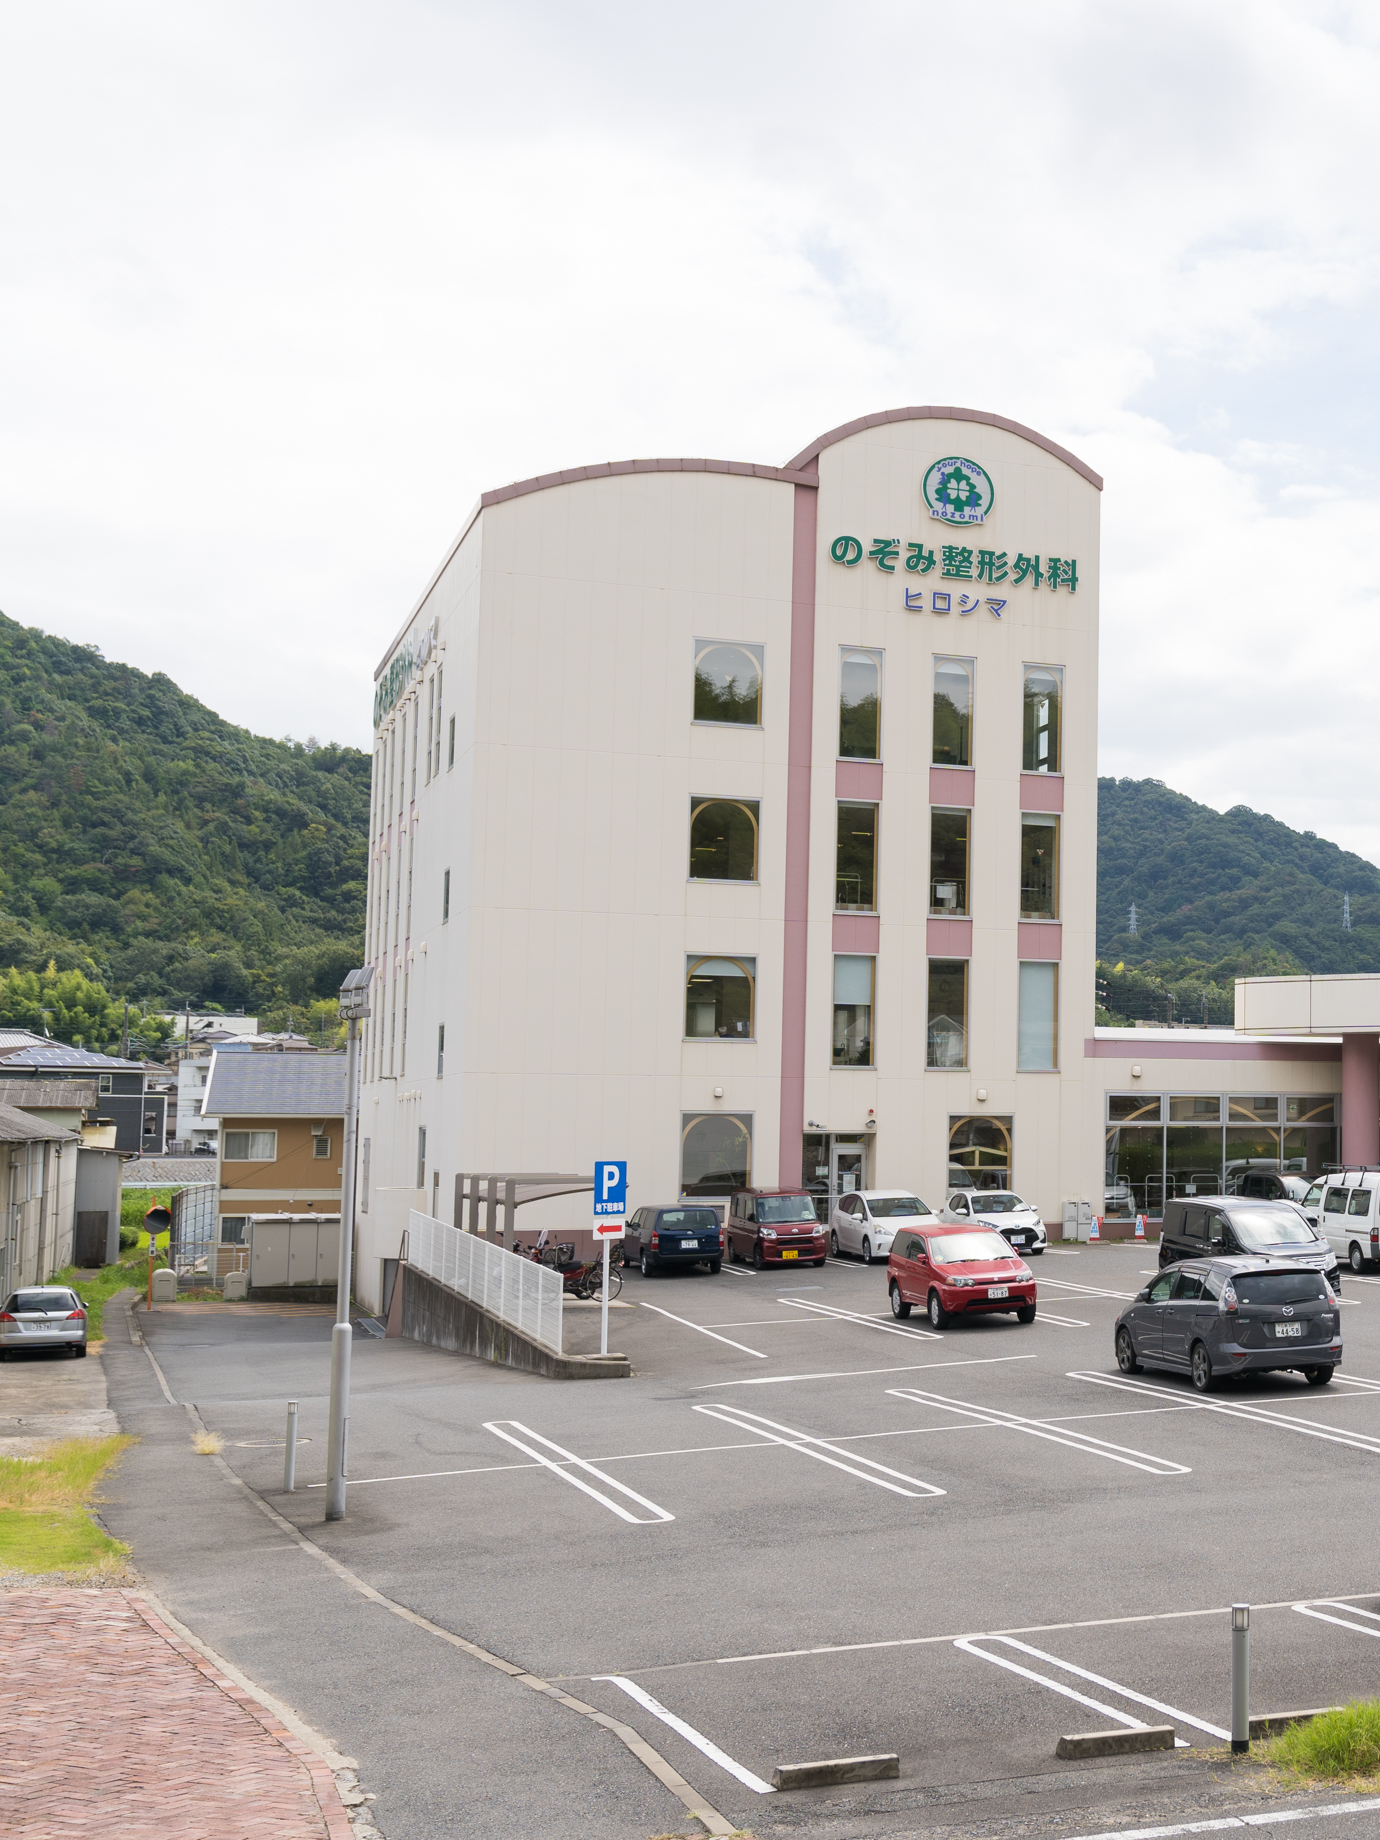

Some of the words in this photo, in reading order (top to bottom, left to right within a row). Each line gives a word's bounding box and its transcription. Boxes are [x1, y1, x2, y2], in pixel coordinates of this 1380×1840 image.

[936, 460, 958, 473] your
[960, 460, 982, 477] hope
[830, 535, 1079, 593] のぞみ整形外科
[904, 587, 1008, 617] ヒロシマ
[602, 1165, 620, 1200] P
